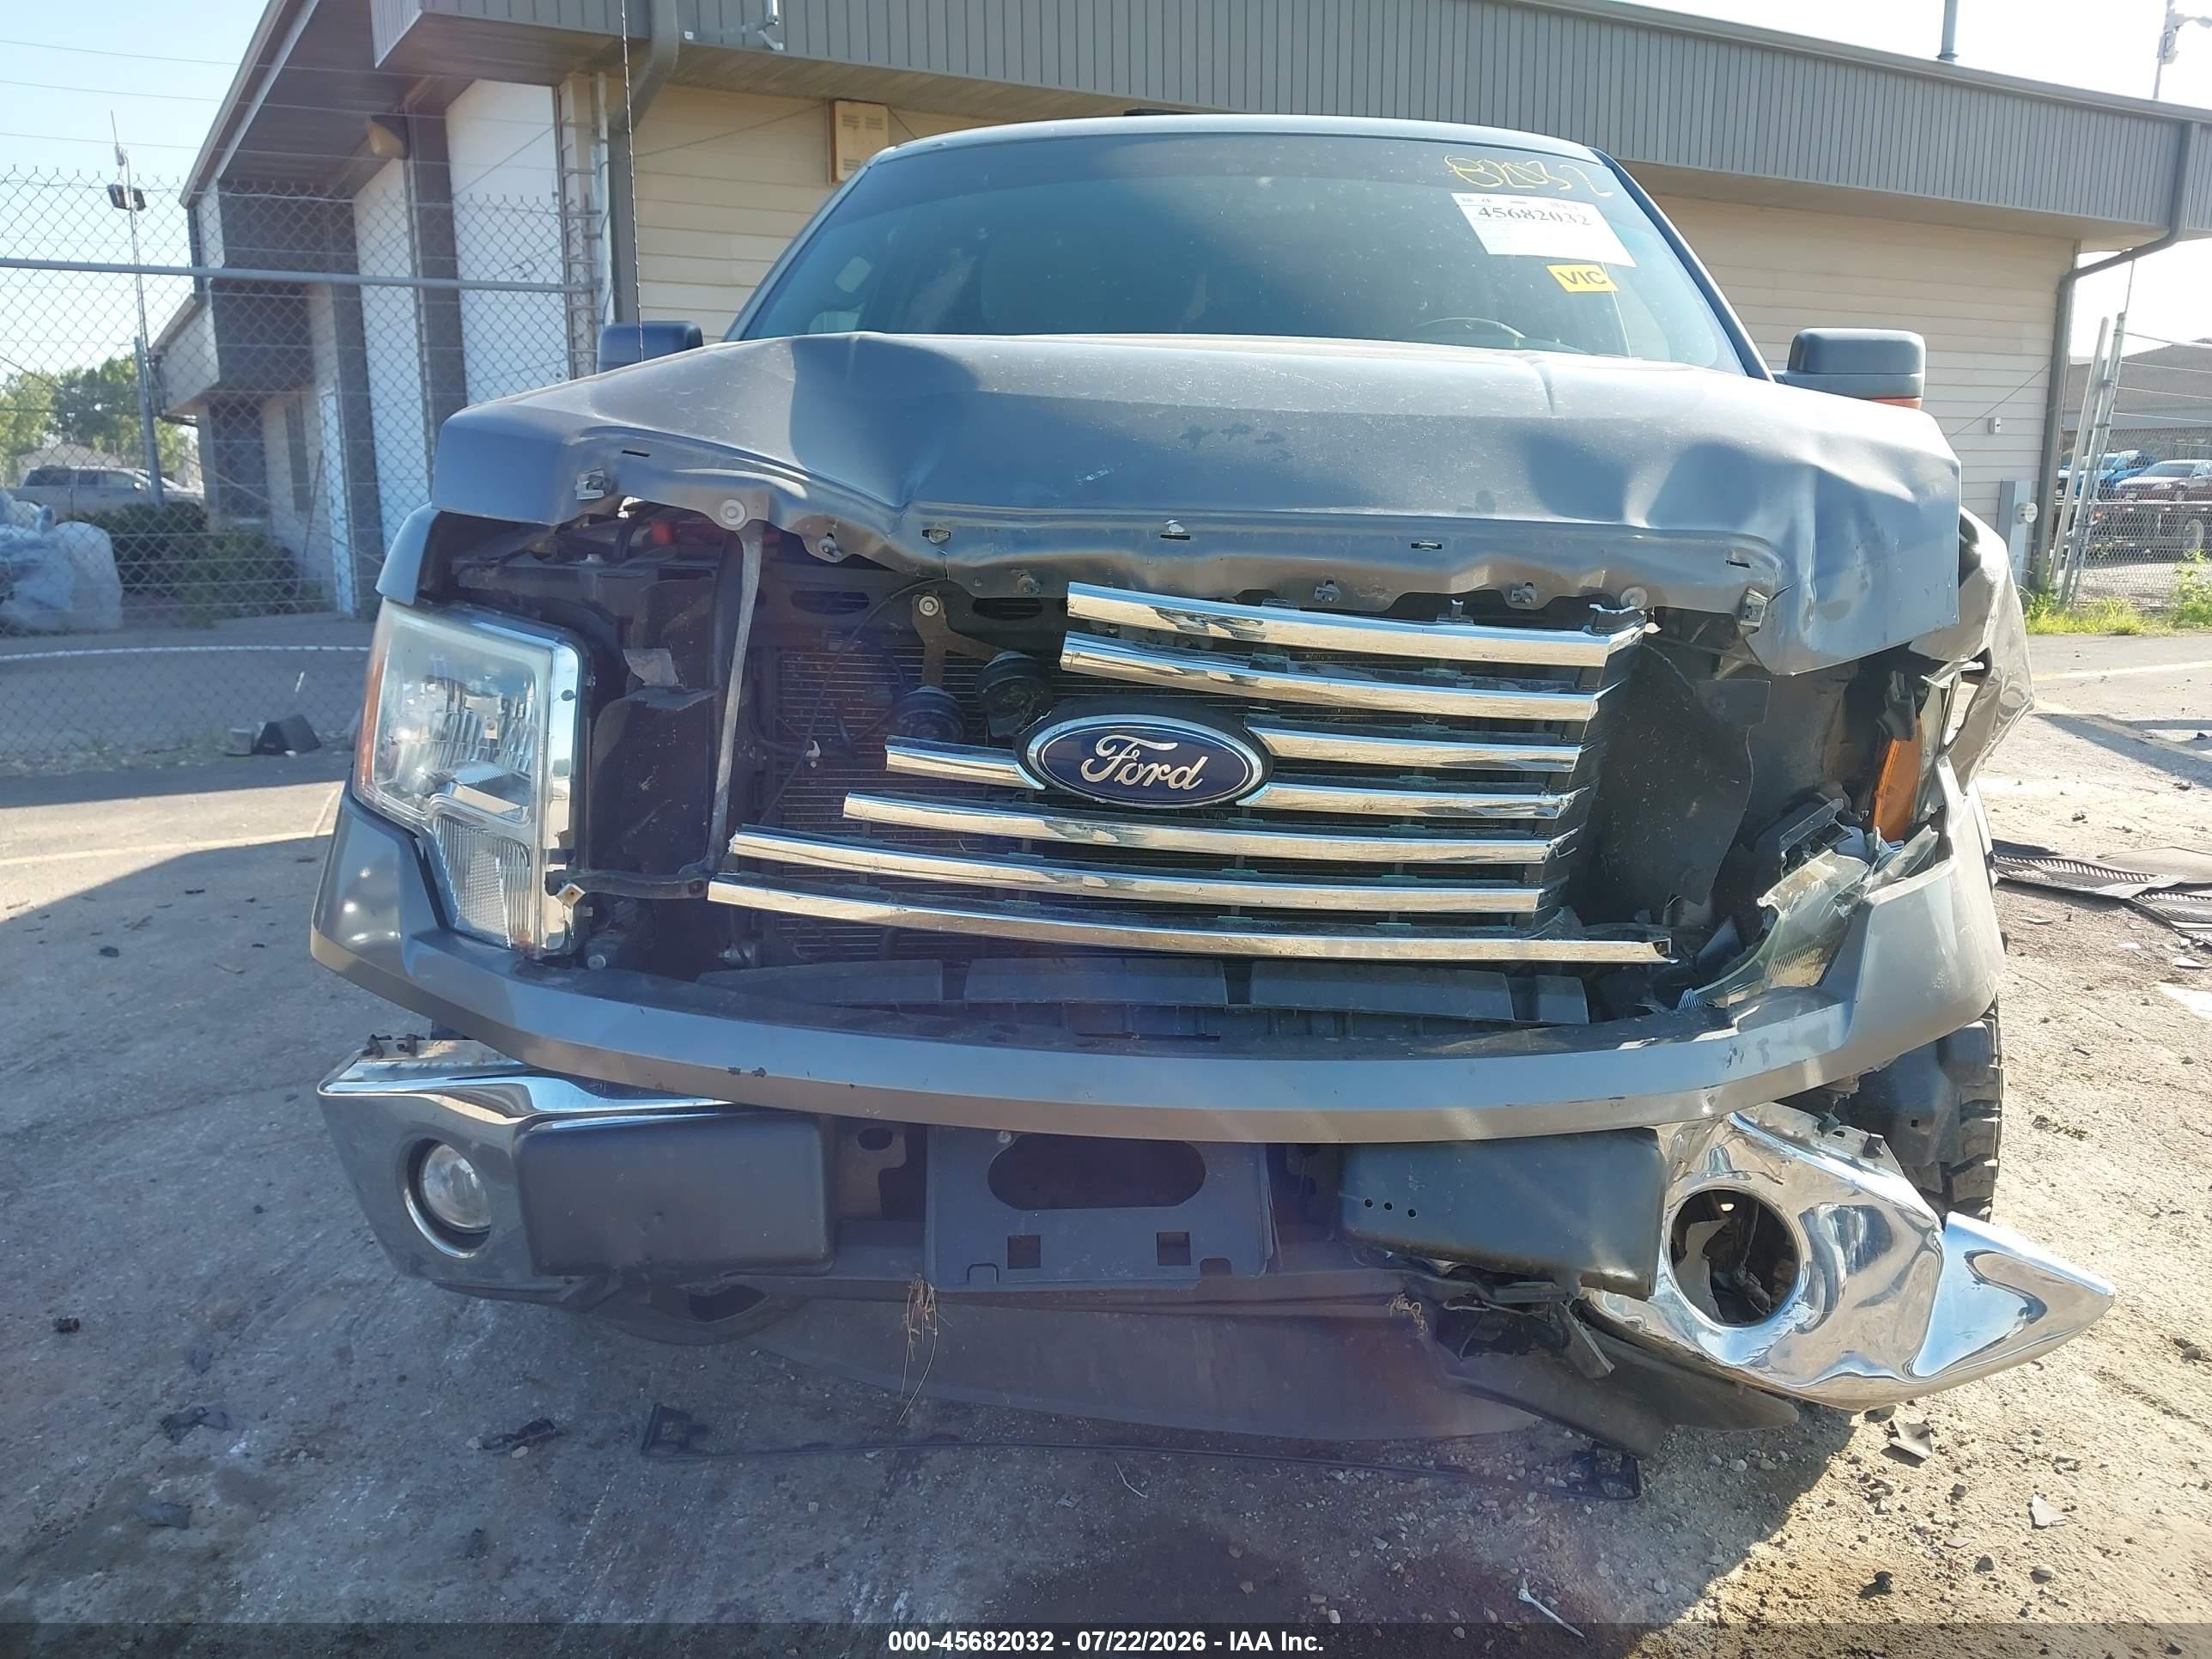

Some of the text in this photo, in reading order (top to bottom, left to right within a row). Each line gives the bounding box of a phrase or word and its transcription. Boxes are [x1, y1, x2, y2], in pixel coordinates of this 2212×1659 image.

[1478, 206, 1592, 226] 45682032
[1557, 270, 1607, 285] VIC
[1081, 734, 1209, 790] Ford
